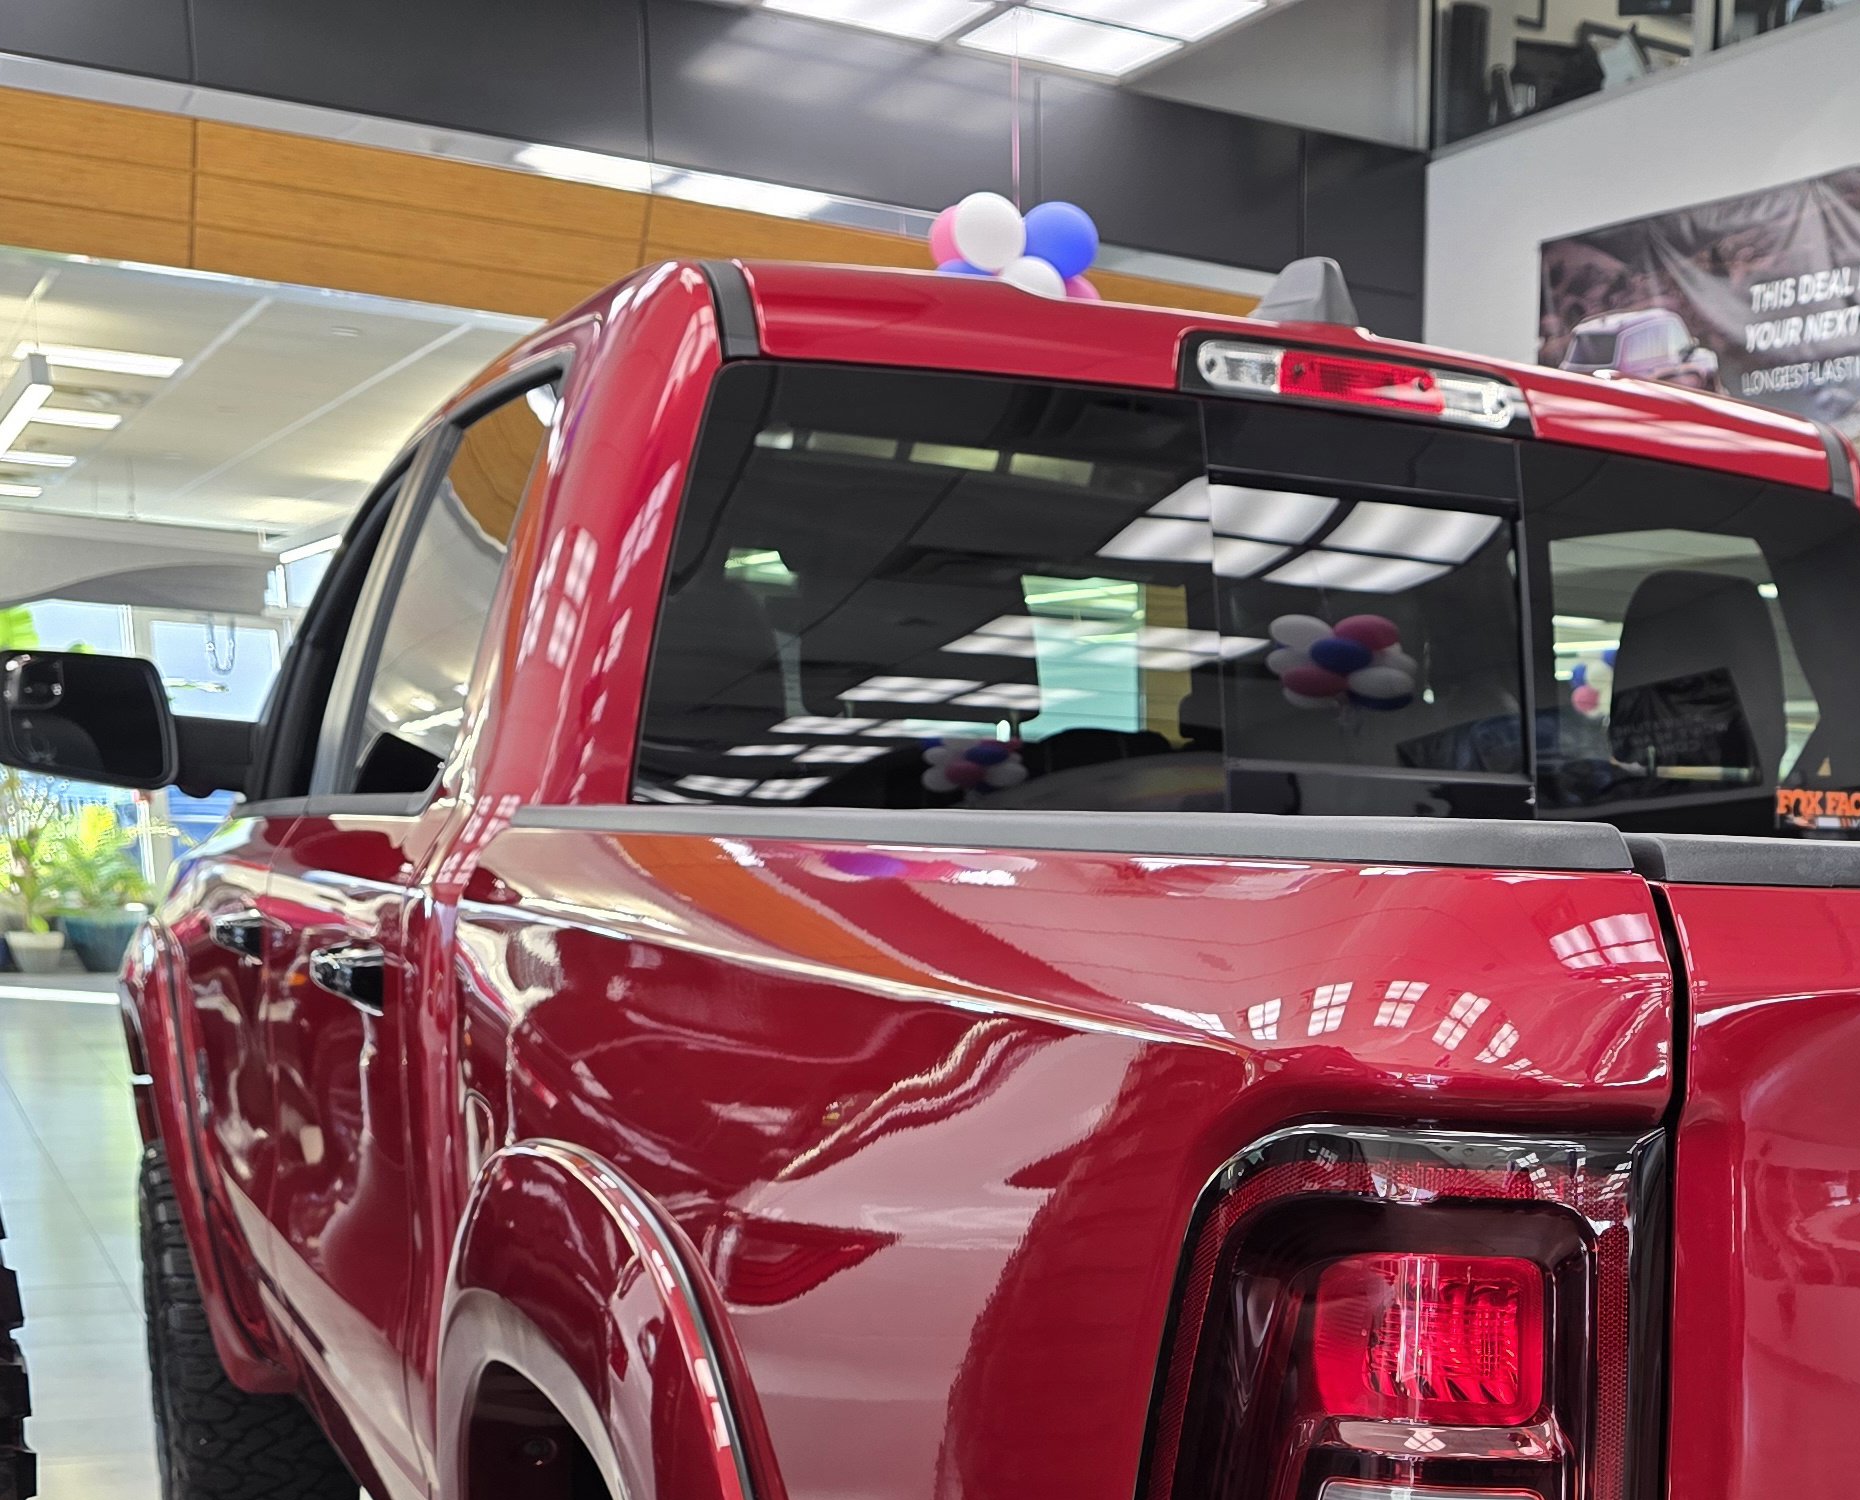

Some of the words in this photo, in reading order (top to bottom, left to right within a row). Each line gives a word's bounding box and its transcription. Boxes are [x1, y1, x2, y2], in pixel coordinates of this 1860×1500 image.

[1750, 278, 1796, 314] THIS
[1798, 267, 1855, 305] DEAL
[1745, 316, 1803, 353] YOUR
[1776, 788, 1823, 817] FOX
